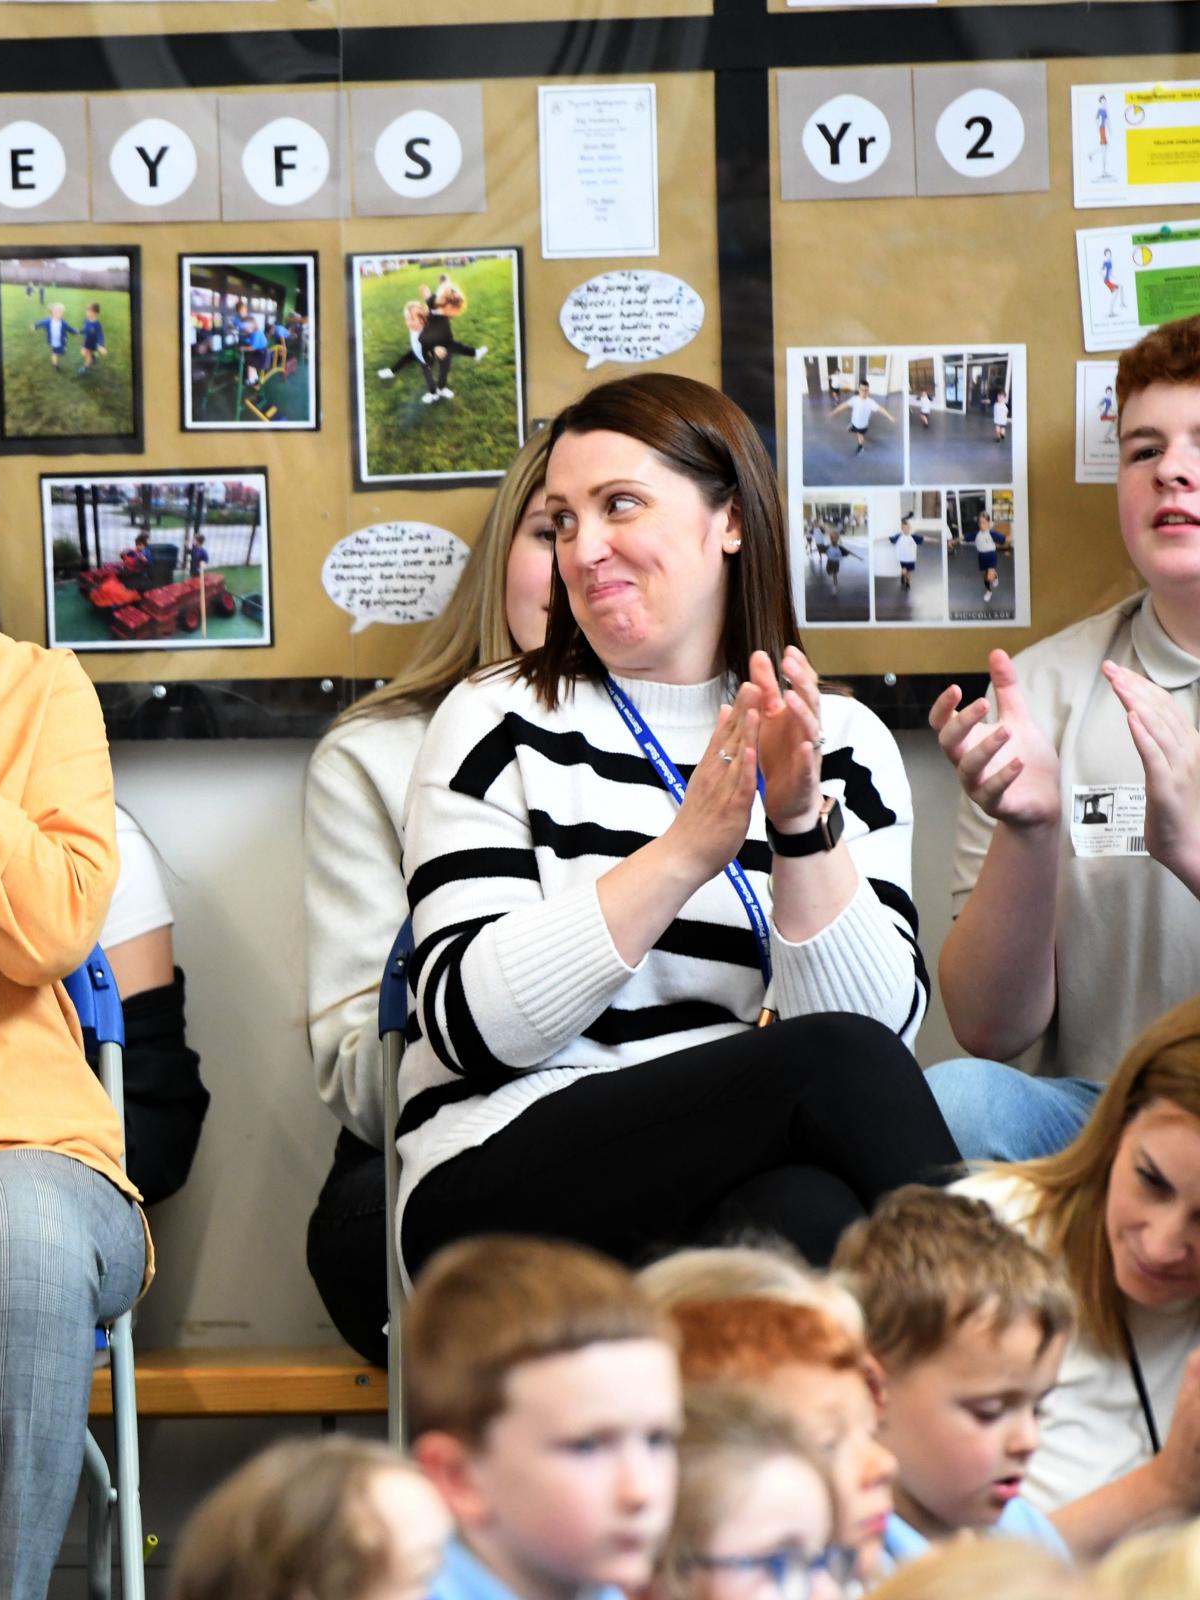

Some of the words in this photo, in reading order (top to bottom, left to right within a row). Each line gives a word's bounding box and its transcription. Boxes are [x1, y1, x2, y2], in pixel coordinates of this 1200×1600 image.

[816, 122, 876, 165] Yr
[964, 116, 994, 159] 2
[624, 707, 643, 735] Barrow
[644, 741, 660, 761] Staff
[656, 758, 676, 785] School
[728, 862, 739, 877] Sta
[735, 876, 754, 905] School
[751, 904, 767, 938] Primary
